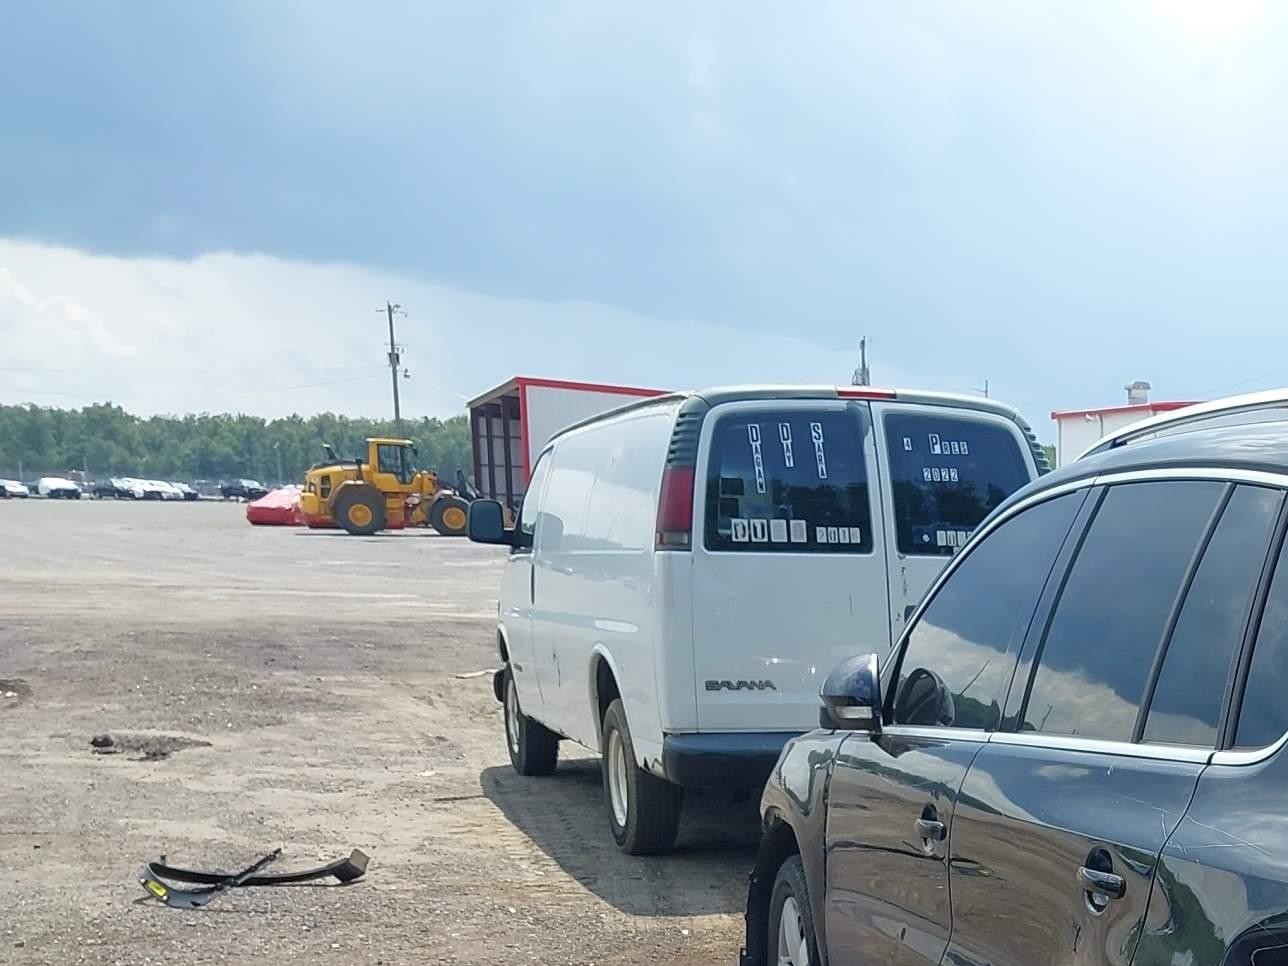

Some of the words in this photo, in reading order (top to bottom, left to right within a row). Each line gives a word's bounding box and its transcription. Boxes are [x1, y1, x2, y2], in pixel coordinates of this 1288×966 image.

[779, 423, 794, 467] DAY
[810, 423, 827, 479] SARA
[923, 468, 958, 481] 2022
